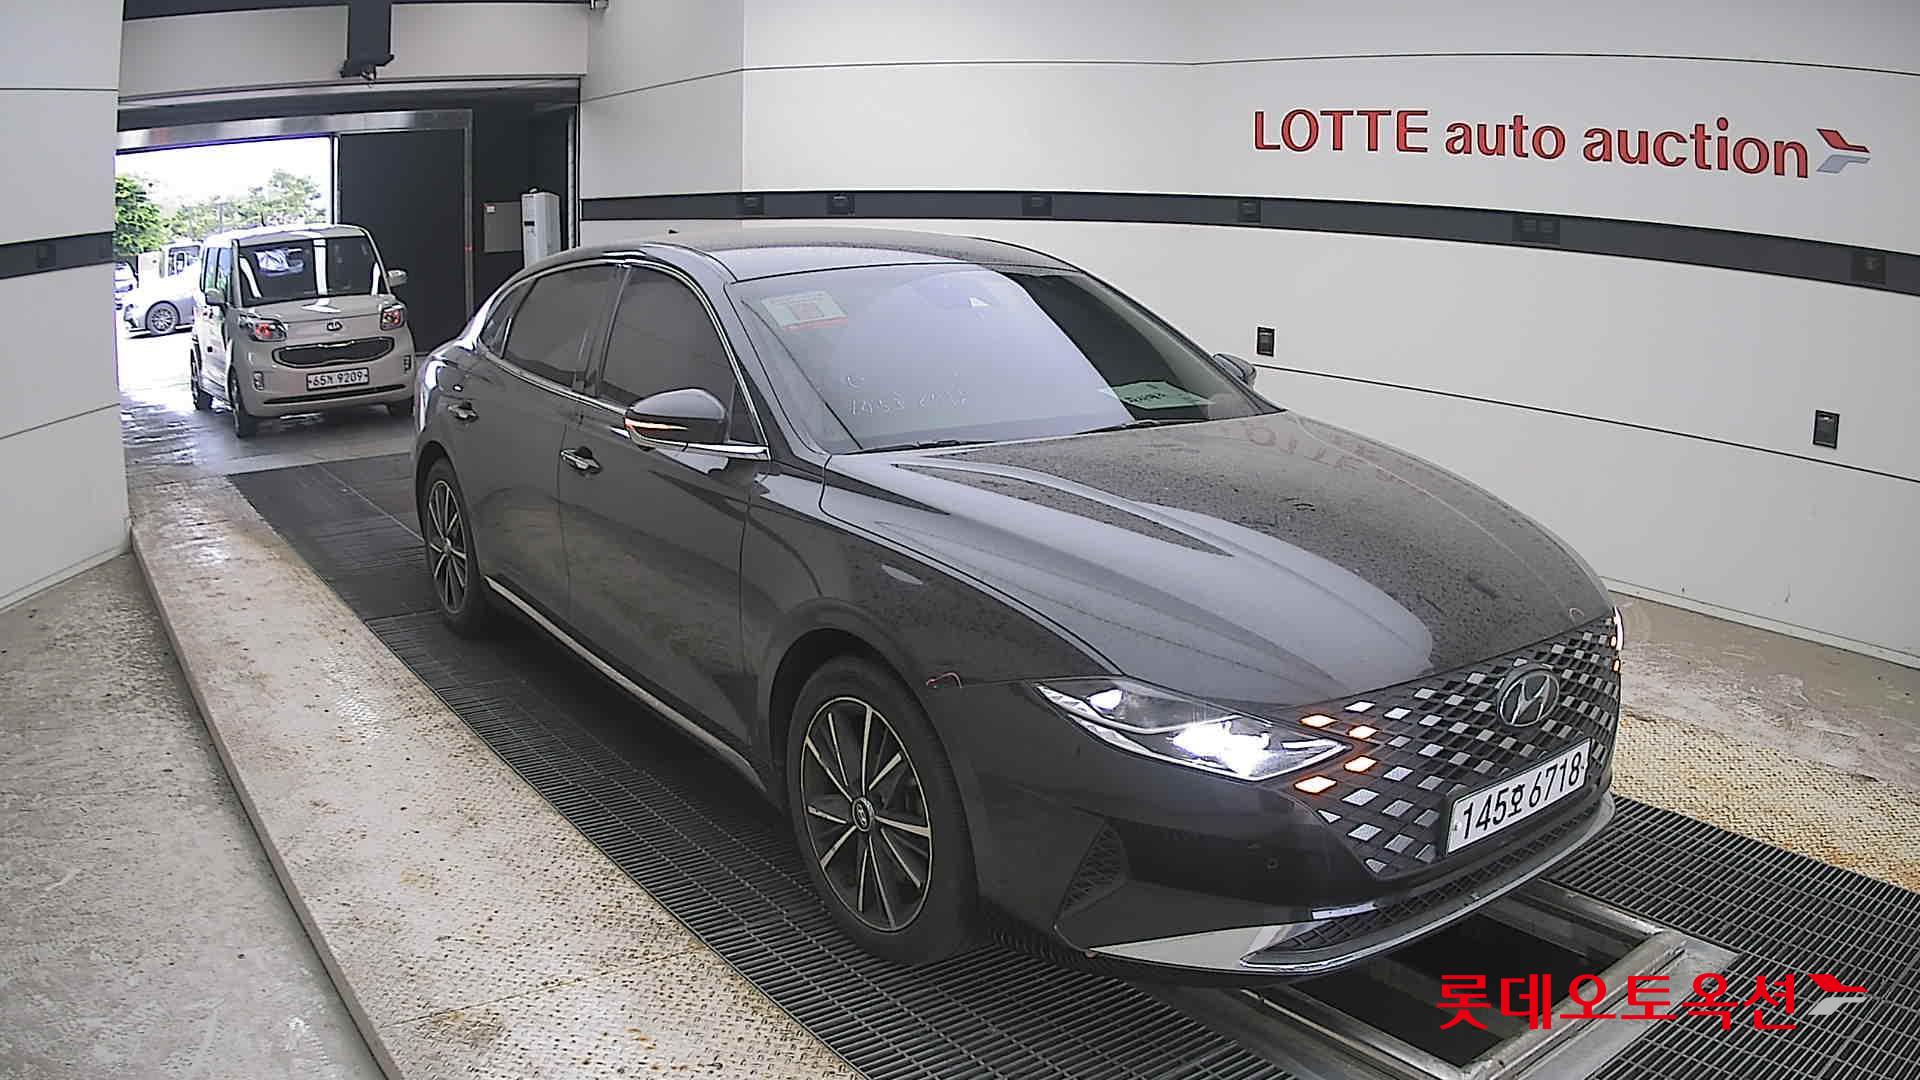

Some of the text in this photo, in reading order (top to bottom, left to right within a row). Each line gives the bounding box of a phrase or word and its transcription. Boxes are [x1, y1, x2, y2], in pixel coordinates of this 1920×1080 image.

[1254, 109, 1809, 179] LOTTE auto auction
